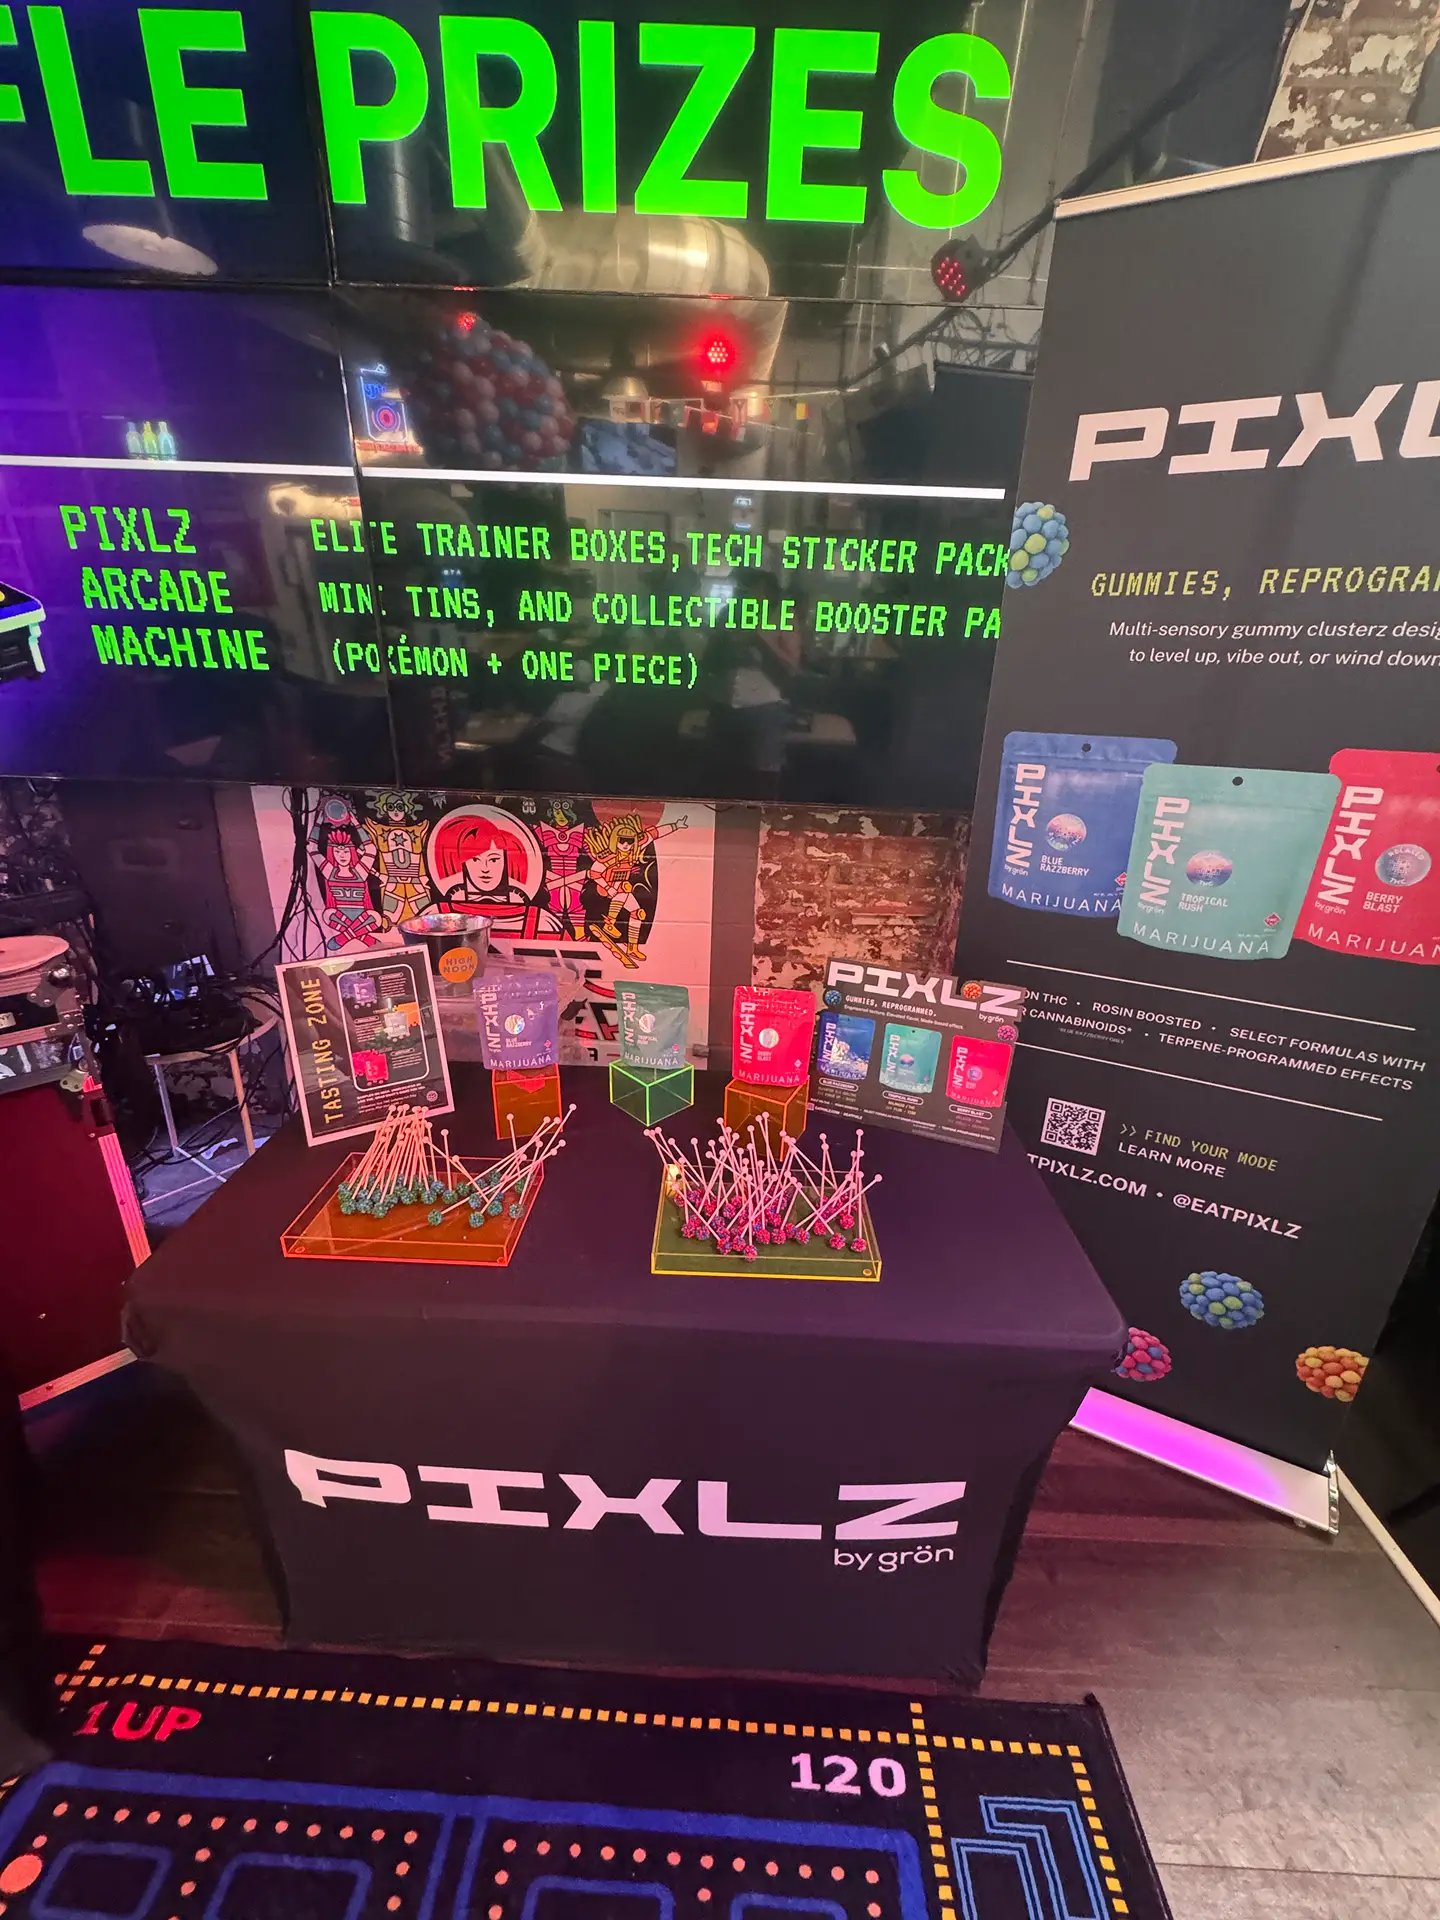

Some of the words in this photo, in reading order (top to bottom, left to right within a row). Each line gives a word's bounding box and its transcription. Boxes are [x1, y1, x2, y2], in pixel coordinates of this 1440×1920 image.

[0, 5, 267, 200] LE
[311, 10, 1010, 229] PRIZES
[59, 504, 197, 554] PIXLZ
[310, 519, 397, 554] ELIE
[416, 523, 551, 560] TRAINER
[783, 537, 917, 574] STICKER
[81, 567, 233, 613] ARCADE
[1091, 570, 1231, 601] GUMMIES,
[318, 582, 386, 616] MIN
[405, 586, 495, 628] TINS,
[519, 590, 572, 622] AND
[592, 593, 795, 631] COLLECTIBLE
[815, 601, 947, 637] BOOSTER
[964, 607, 1001, 638] PA
[91, 625, 270, 670] MACHINE
[1109, 621, 1228, 639] Multi-sensory
[1231, 623, 1301, 640] gummy
[1306, 621, 1387, 637] clusterz
[522, 650, 573, 681] ONE
[594, 652, 698, 689] PIECE)
[1129, 649, 1145, 663] to
[1150, 649, 1189, 663] level
[1195, 651, 1221, 667] up,
[1226, 649, 1264, 664] vibe
[1269, 650, 1303, 667] out,
[1309, 653, 1330, 664] or
[1335, 649, 1386, 665] wind
[1006, 763, 1046, 867] PIXLZ
[1041, 855, 1063, 865] BLUE
[1139, 796, 1189, 907] PIXLZ
[1317, 785, 1384, 906] PIXLZ
[1040, 863, 1090, 876] RAZZBERRY
[1002, 883, 1122, 912] MARIJUANA
[1178, 902, 1203, 913] RUSH
[1181, 893, 1229, 907] TROPICAL
[1363, 901, 1400, 914] BLAST
[1366, 891, 1403, 904] BERRY
[1133, 922, 1269, 954] MARIJUANA
[444, 964, 474, 973] NOON
[446, 956, 472, 965] HIGH
[300, 978, 327, 1027] ZONE
[827, 961, 1022, 1017] PIXLZ
[979, 1013, 988, 1022] by
[1043, 993, 1068, 1006] THC
[1092, 1002, 1133, 1018] ROSIN
[1136, 1010, 1201, 1031] BOOSTED
[1229, 1026, 1287, 1047] SELECT
[1289, 1038, 1378, 1064] FORMULAS
[1382, 1055, 1426, 1073] WITH
[490, 1054, 552, 1068] MARIJUANA
[624, 1052, 679, 1066] MARIJUANA
[738, 1069, 800, 1083] MARIJUANA
[1159, 1032, 1337, 1076] TERPENE-PROGRAMMED
[1340, 1067, 1412, 1091] EFFECTS
[312, 1039, 343, 1124] TASTING
[1118, 1142, 1171, 1165] LEARN
[1176, 1157, 1226, 1178] MORE
[1144, 1129, 1181, 1148] FIND
[1191, 1140, 1228, 1160] YOUR
[1238, 1152, 1278, 1172] MODE
[1173, 1193, 1302, 1239] @EATPIXLZ
[284, 1449, 967, 1540] PIXLZ
[833, 1546, 872, 1570] by
[877, 1546, 953, 1573] grön
[791, 1752, 906, 1797] 120
